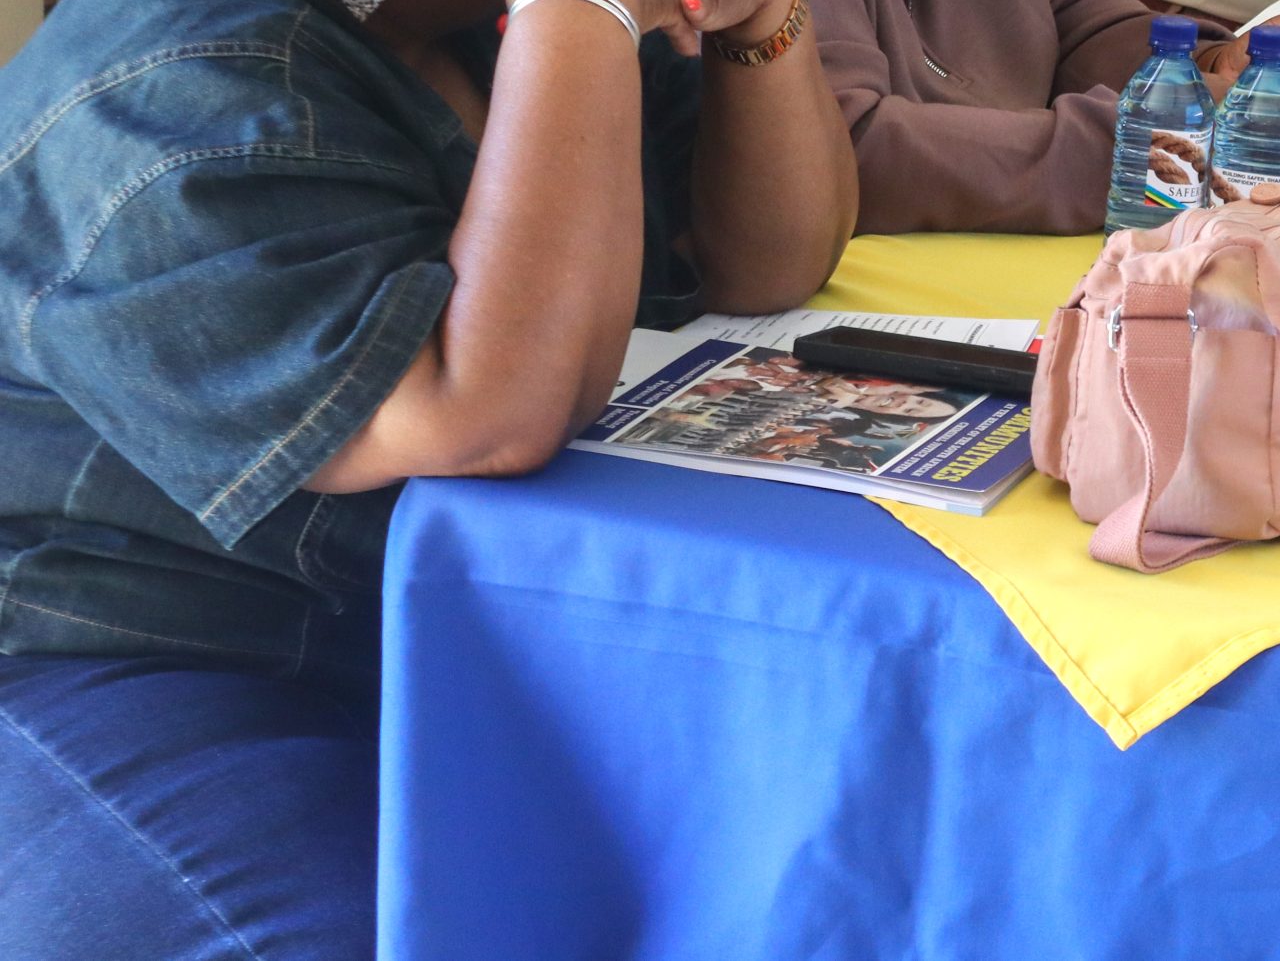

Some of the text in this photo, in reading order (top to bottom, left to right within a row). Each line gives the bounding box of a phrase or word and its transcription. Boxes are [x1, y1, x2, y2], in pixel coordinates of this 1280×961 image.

[1222, 171, 1246, 179] BUILDING
[1227, 177, 1257, 186] CONFIDENT
[991, 406, 1008, 418] THE
[975, 416, 998, 432] HEART
[967, 430, 981, 438] OF
[954, 435, 971, 446] THE
[891, 421, 970, 474] CRIMINAL JUSTICE SYSTEM
[939, 443, 961, 460] SOUTH
[911, 456, 943, 477] AFRICAN
